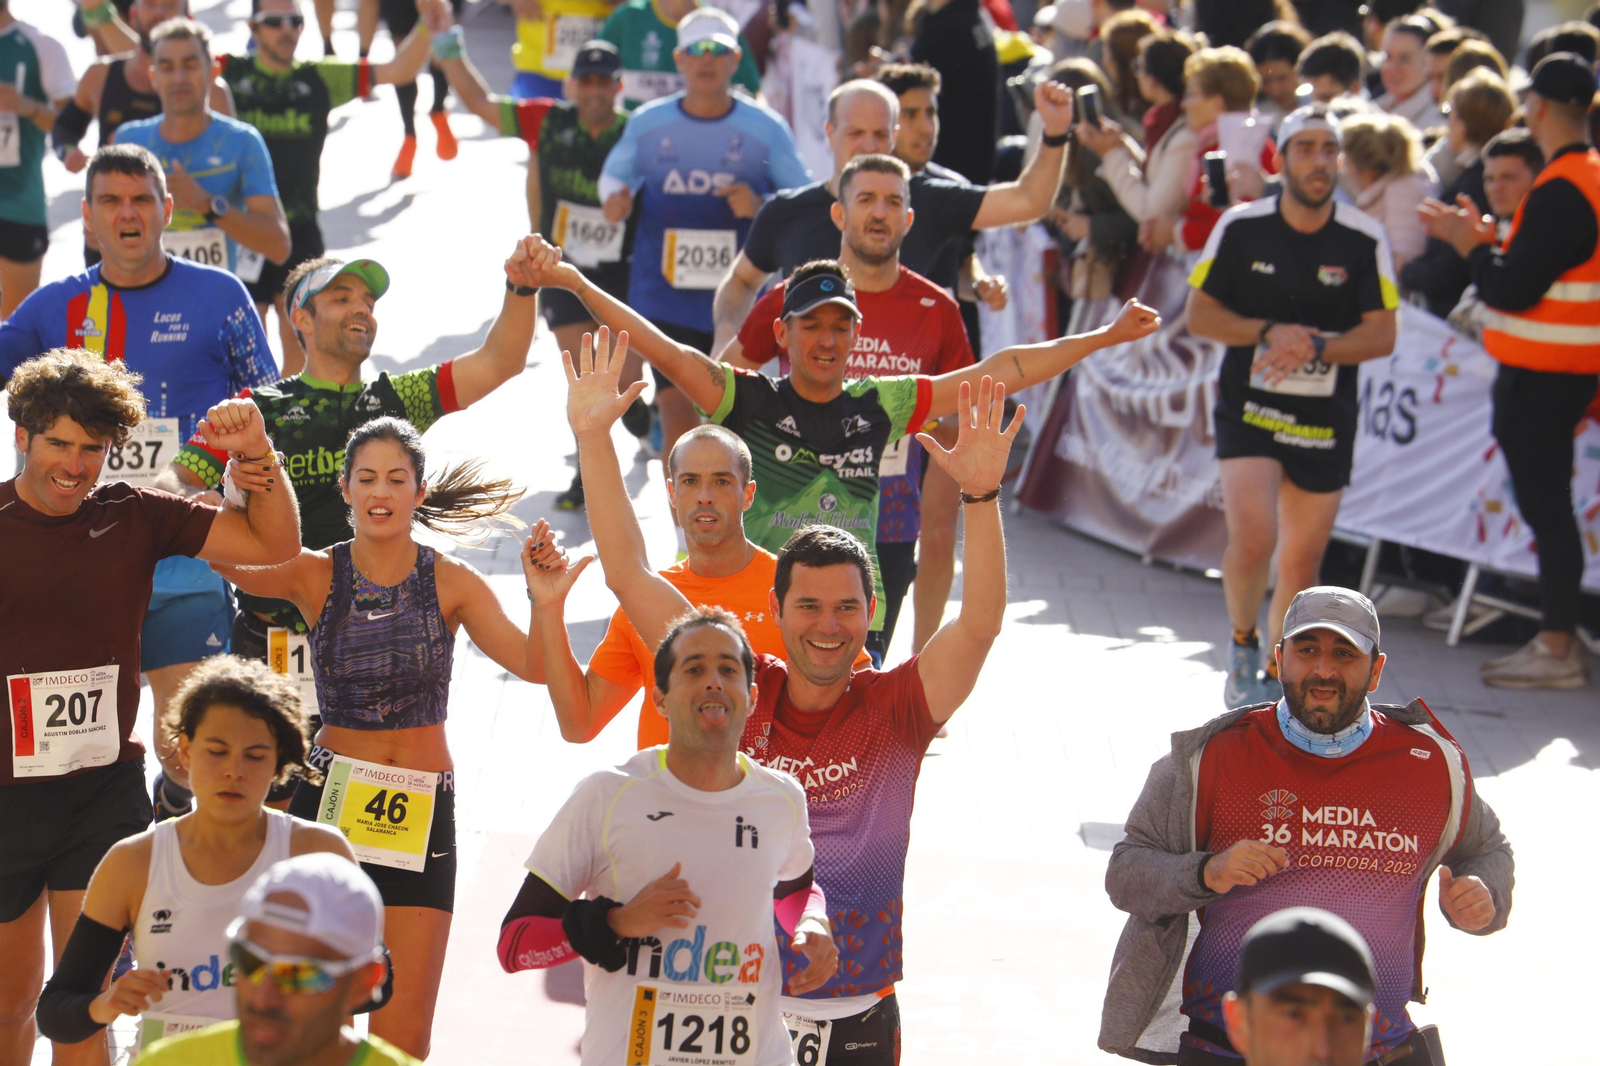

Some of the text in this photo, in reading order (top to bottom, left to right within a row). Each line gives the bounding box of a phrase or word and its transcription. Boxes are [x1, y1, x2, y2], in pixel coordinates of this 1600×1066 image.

[662, 168, 736, 195] ADS
[571, 221, 618, 245] 1607
[678, 246, 730, 267] 2036
[1251, 260, 1276, 274] FILA
[853, 337, 891, 354] EDIA
[107, 441, 163, 470] 837
[836, 466, 875, 478] TRAIL
[45, 673, 88, 686] IMDECO
[45, 689, 103, 728] 207
[18, 706, 29, 739] CAJÓN
[309, 745, 334, 770] PR
[364, 768, 405, 784] IMDECO
[804, 756, 859, 790] ATÓN
[834, 778, 864, 801] 2022
[325, 788, 339, 820] CAJÓN
[364, 789, 409, 824] 46
[356, 818, 373, 826] MARIA
[388, 824, 409, 832] CHACON
[1302, 805, 1377, 828] MEDIA
[366, 826, 397, 836] SALAMANCA
[1259, 824, 1418, 854] 36 MARATÓN
[1298, 852, 1417, 875] CÓRDOBA 2022
[673, 993, 721, 1005] IMDECO
[635, 1020, 646, 1058] CAJÓN
[657, 1012, 750, 1056] 1218
[667, 1056, 690, 1064] JAVIER
[690, 1056, 710, 1065] LÓPEZ
